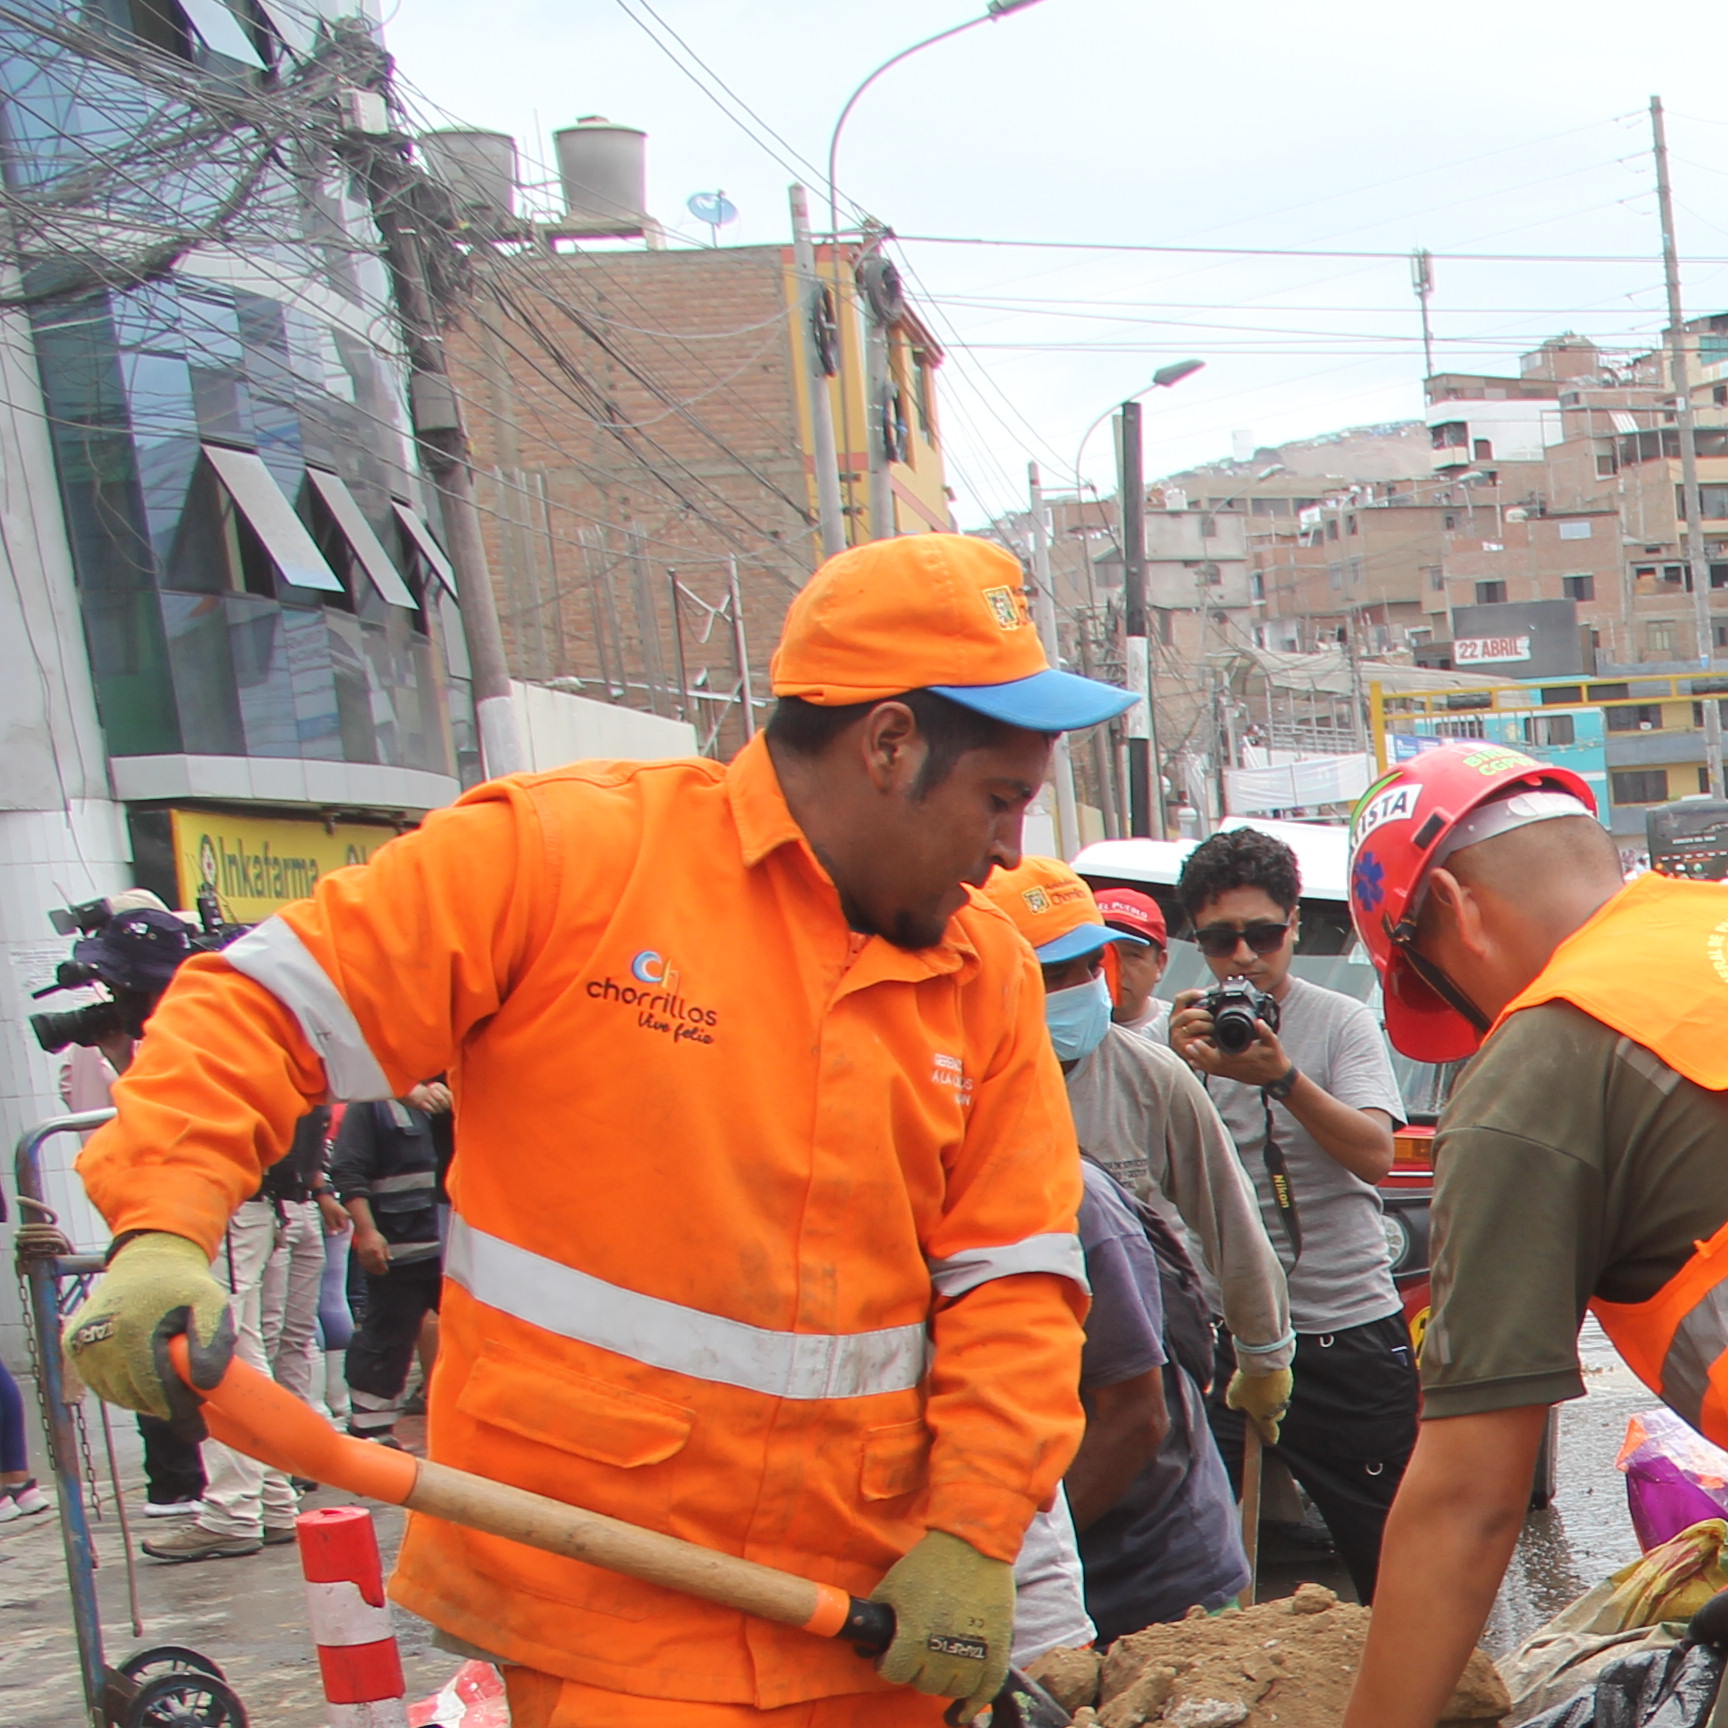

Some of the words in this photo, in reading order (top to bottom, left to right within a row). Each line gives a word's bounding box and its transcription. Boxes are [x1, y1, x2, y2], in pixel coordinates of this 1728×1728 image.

[1459, 641, 1479, 659] 22
[1482, 638, 1522, 658] ABRIL
[218, 836, 319, 899] Inkafarma
[586, 976, 718, 1027] chorrillos
[1273, 1174, 1290, 1208] Nikon
